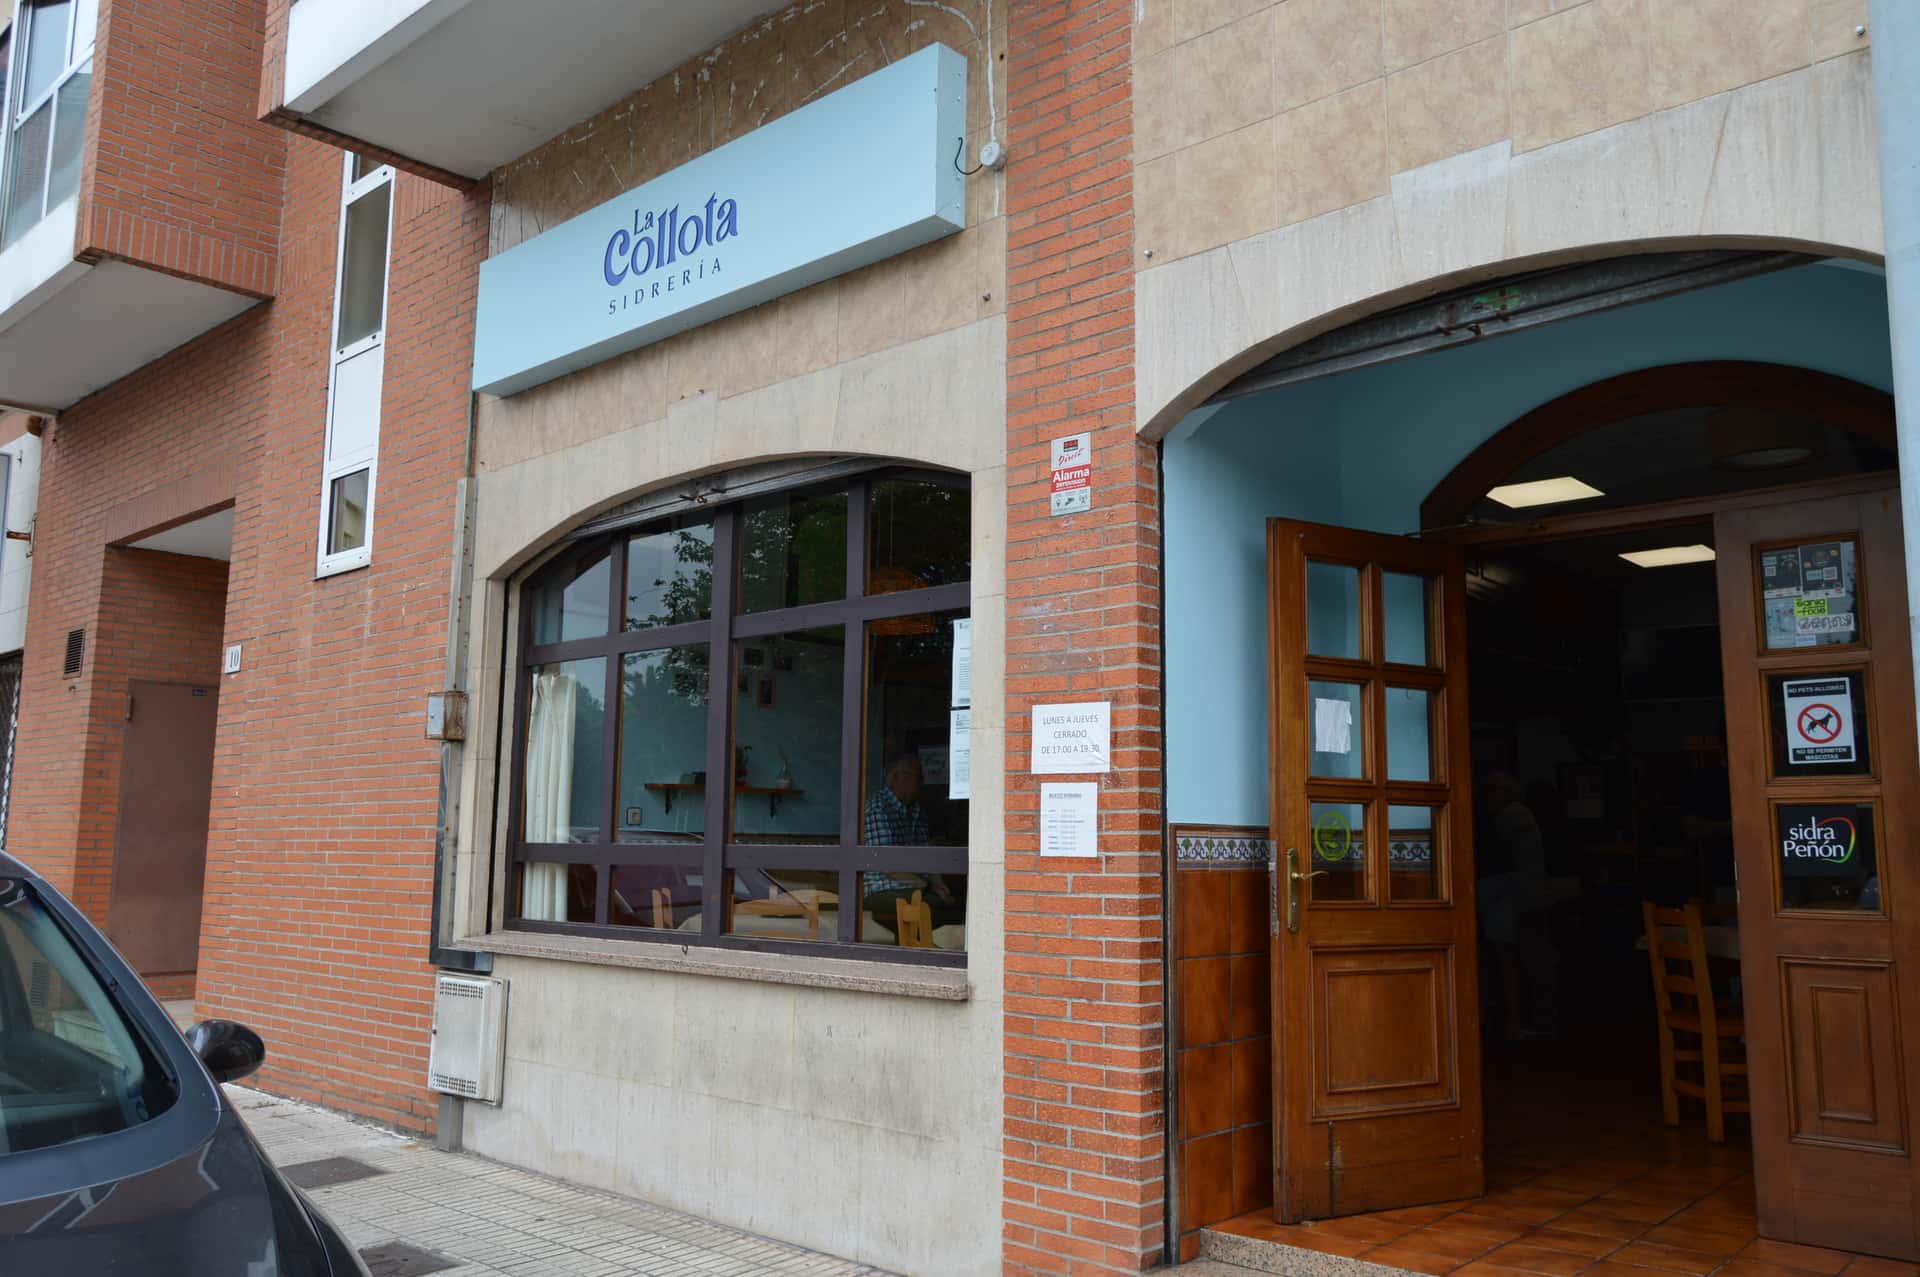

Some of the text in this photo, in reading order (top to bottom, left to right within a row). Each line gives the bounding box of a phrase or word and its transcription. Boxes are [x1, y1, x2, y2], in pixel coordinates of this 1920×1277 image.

[634, 208, 655, 236] La
[603, 191, 739, 287] Collota
[608, 257, 722, 316] SIDRERÍA
[1052, 467, 1091, 483] Alarma
[230, 649, 240, 668] 10
[1042, 715, 1065, 725] LUNES
[1073, 713, 1099, 723] JUEVES
[1053, 729, 1087, 739] CERRADO
[1041, 745, 1051, 754] DE
[1790, 816, 1836, 841] sidra
[1783, 840, 1846, 858] Peñón
